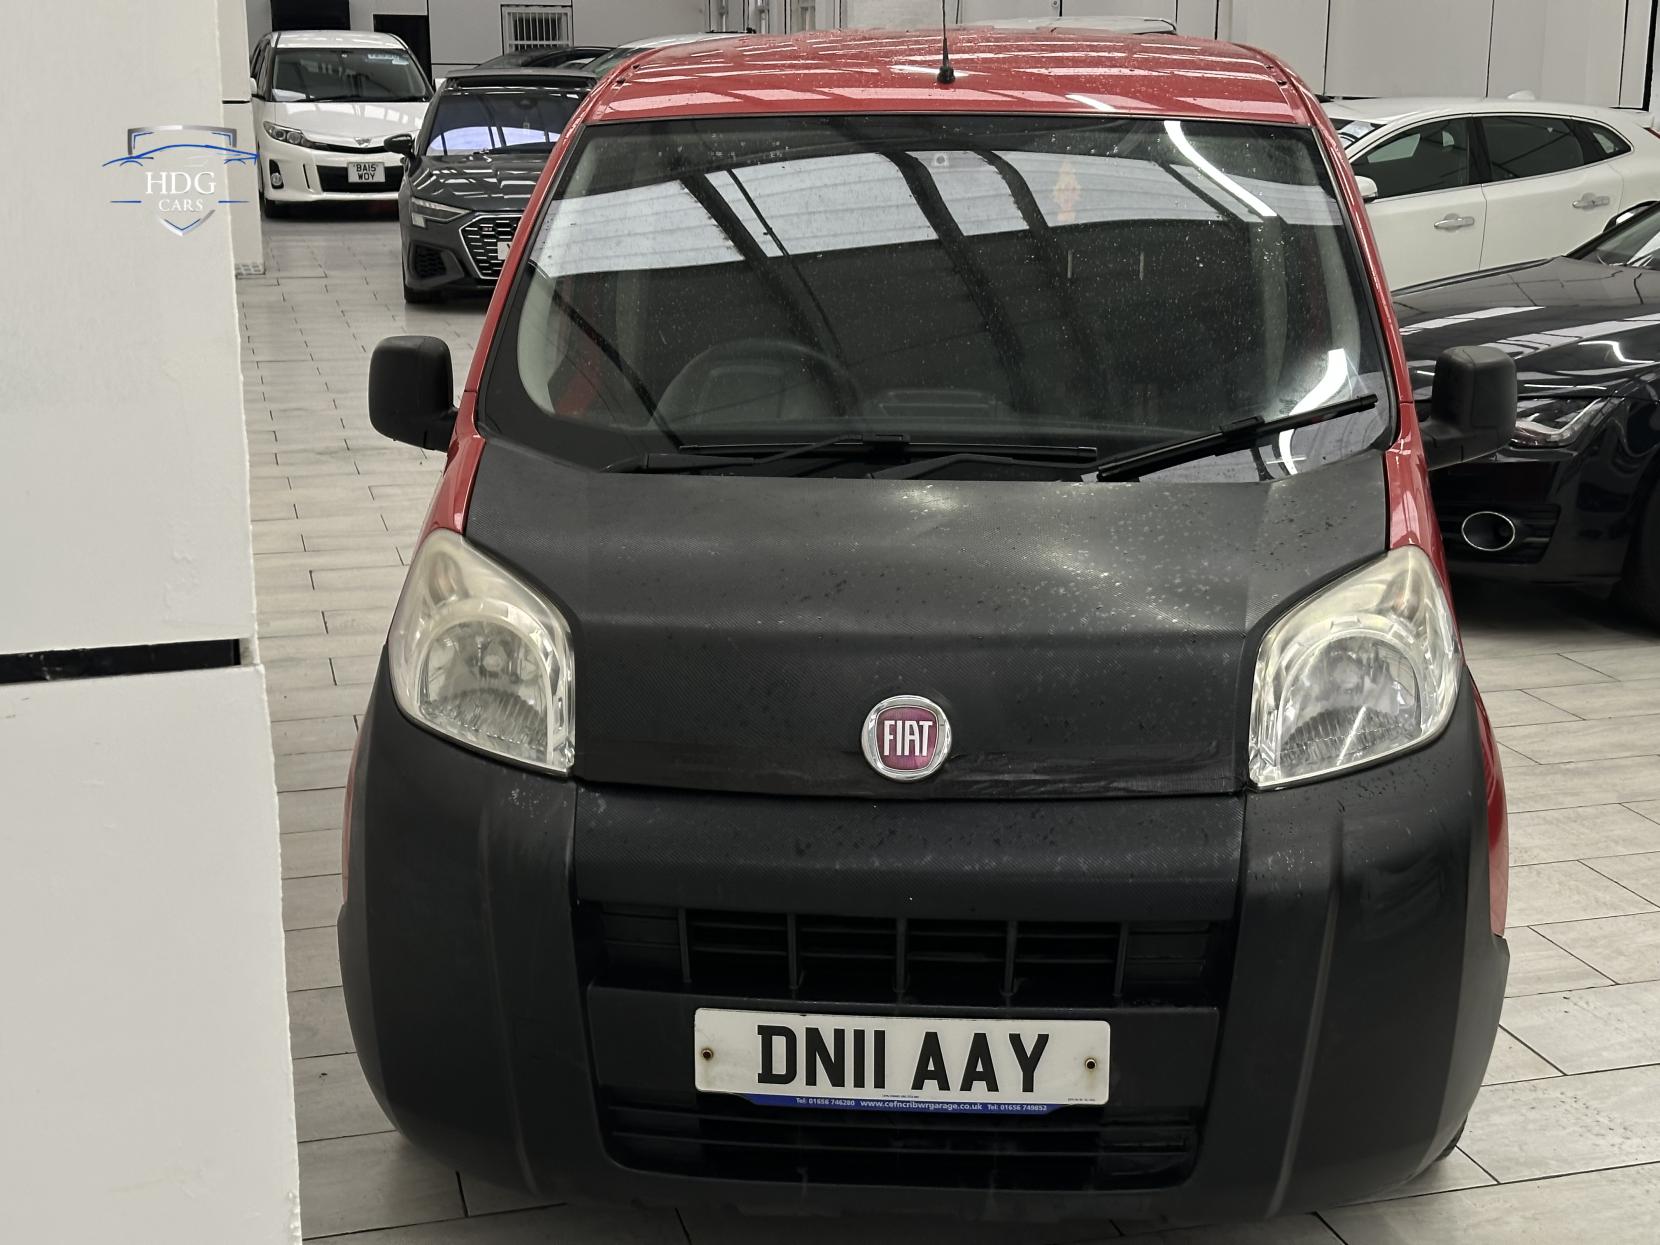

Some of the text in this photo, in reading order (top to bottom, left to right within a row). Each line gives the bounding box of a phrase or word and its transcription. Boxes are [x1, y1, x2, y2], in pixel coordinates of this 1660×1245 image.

[356, 163, 376, 172] BA15
[883, 720, 933, 756] FIAT
[757, 1024, 1050, 1093] DN11 AAY
